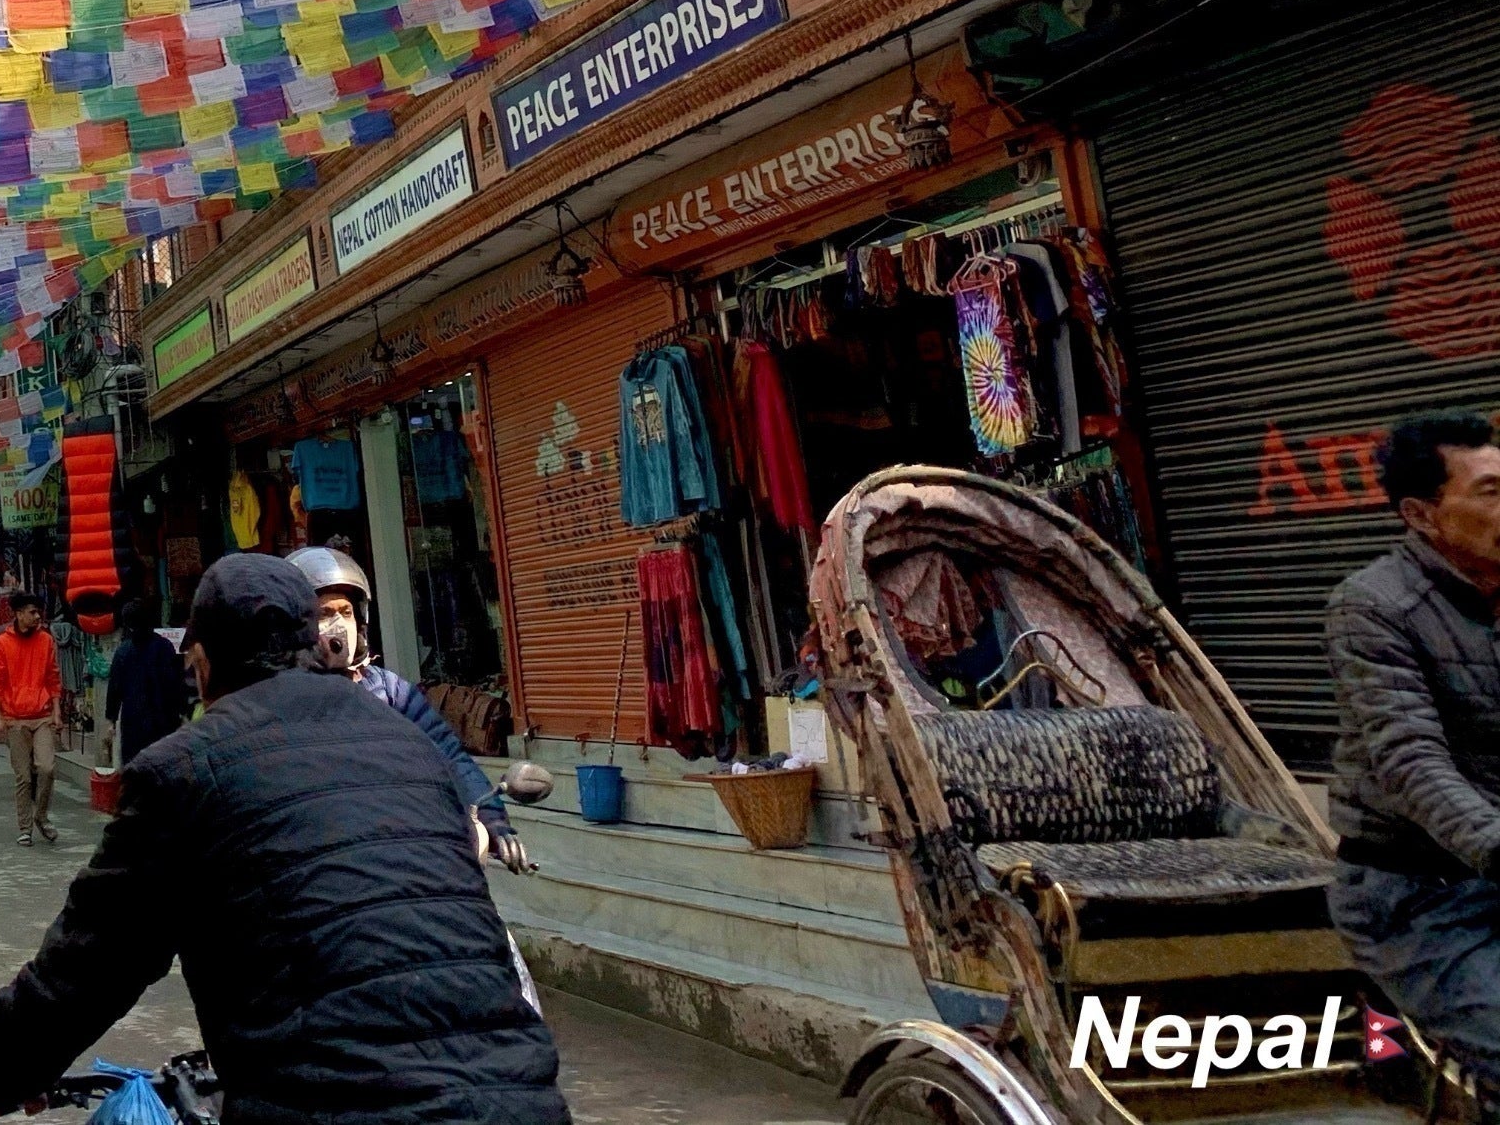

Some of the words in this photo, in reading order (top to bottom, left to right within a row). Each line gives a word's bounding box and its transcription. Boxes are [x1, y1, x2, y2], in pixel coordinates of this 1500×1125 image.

[506, 72, 580, 152] PEACE
[336, 217, 365, 259] NEPAL
[363, 192, 401, 242] COTTON
[398, 149, 467, 220] HANDICRAFT
[632, 185, 723, 249] PEACE
